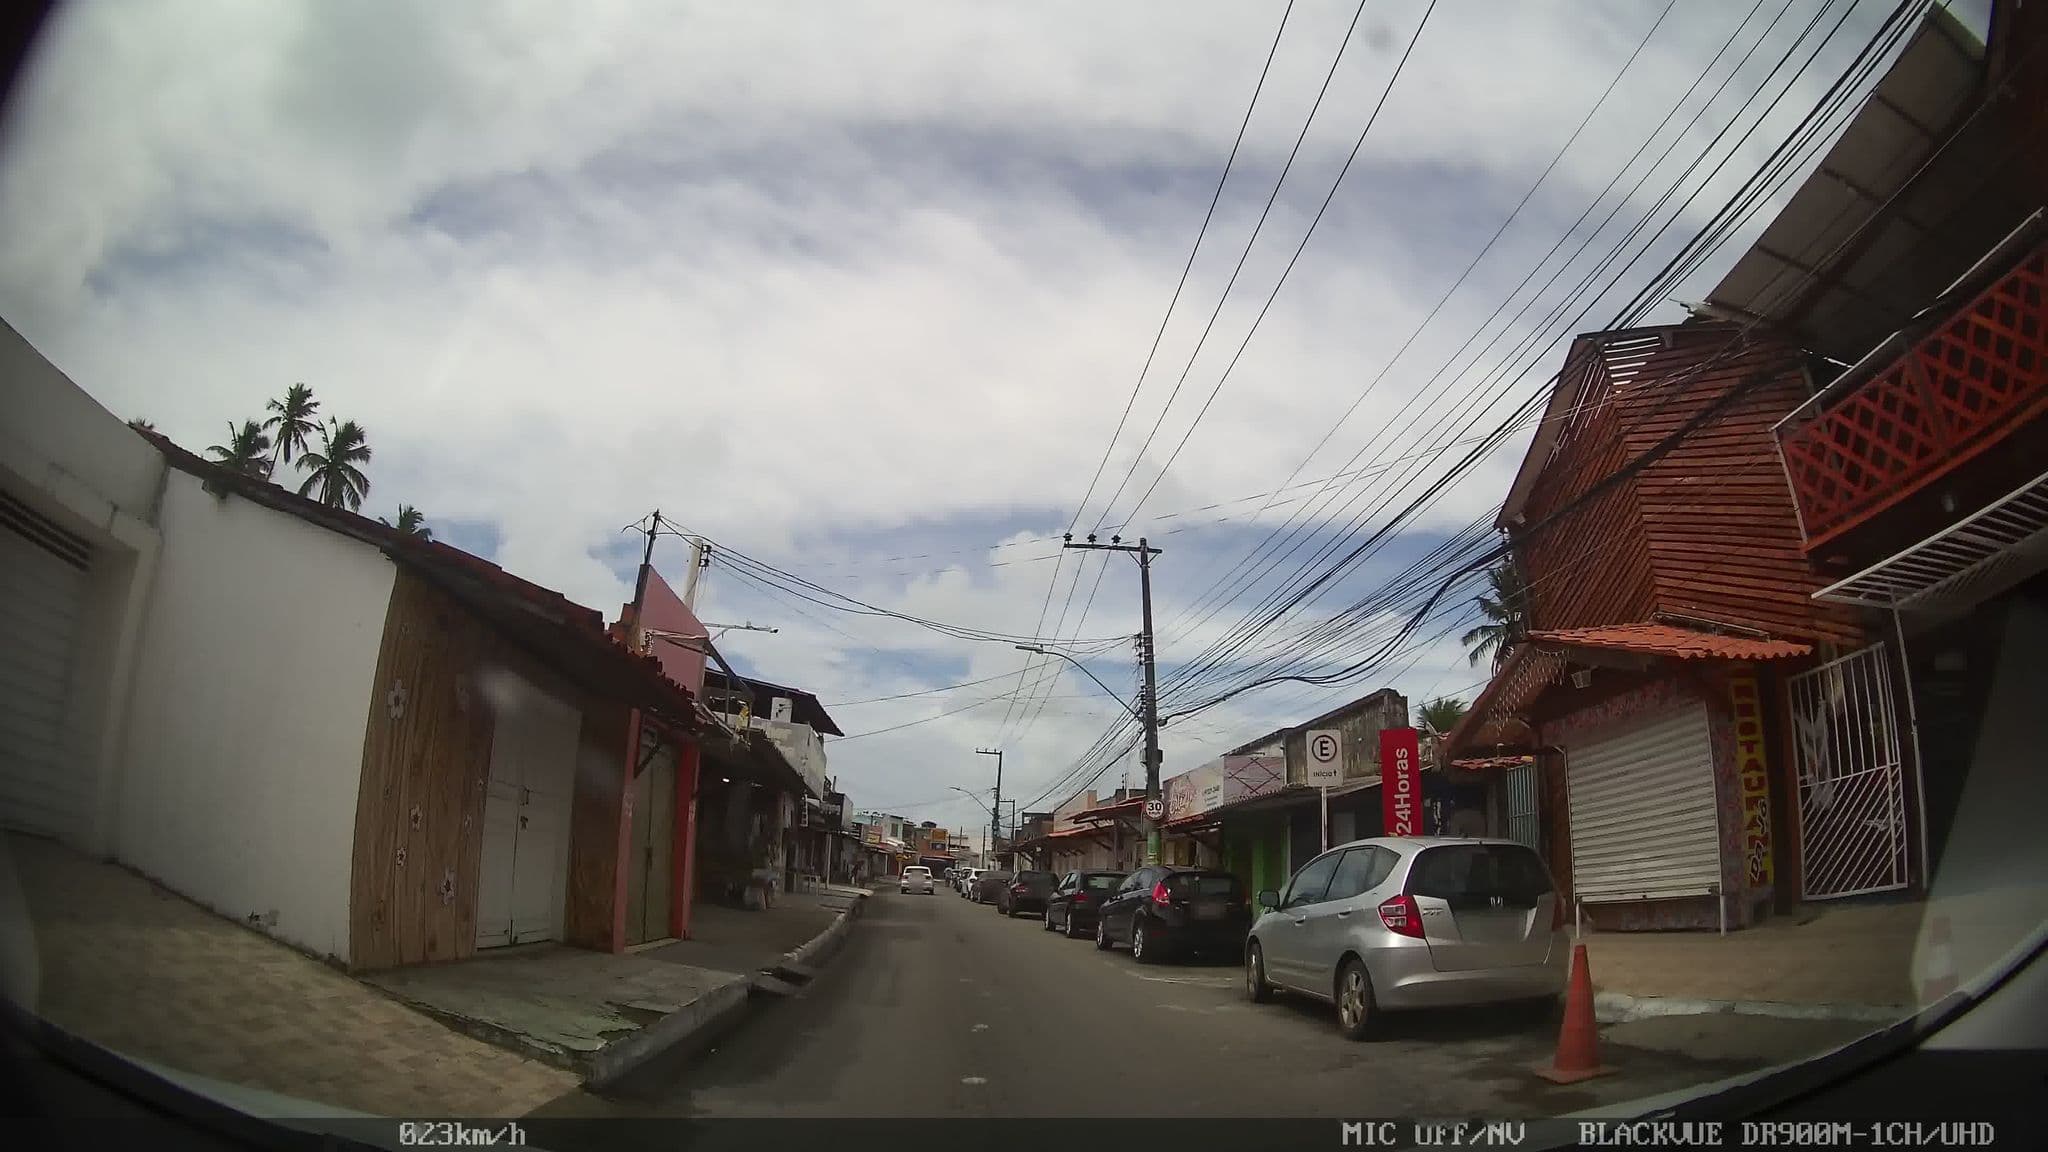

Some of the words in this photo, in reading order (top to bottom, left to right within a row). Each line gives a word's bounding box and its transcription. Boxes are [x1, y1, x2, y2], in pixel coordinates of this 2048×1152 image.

[1320, 740, 1330, 757] E
[1394, 747, 1413, 837] 24Horas
[1147, 802, 1161, 811] 30
